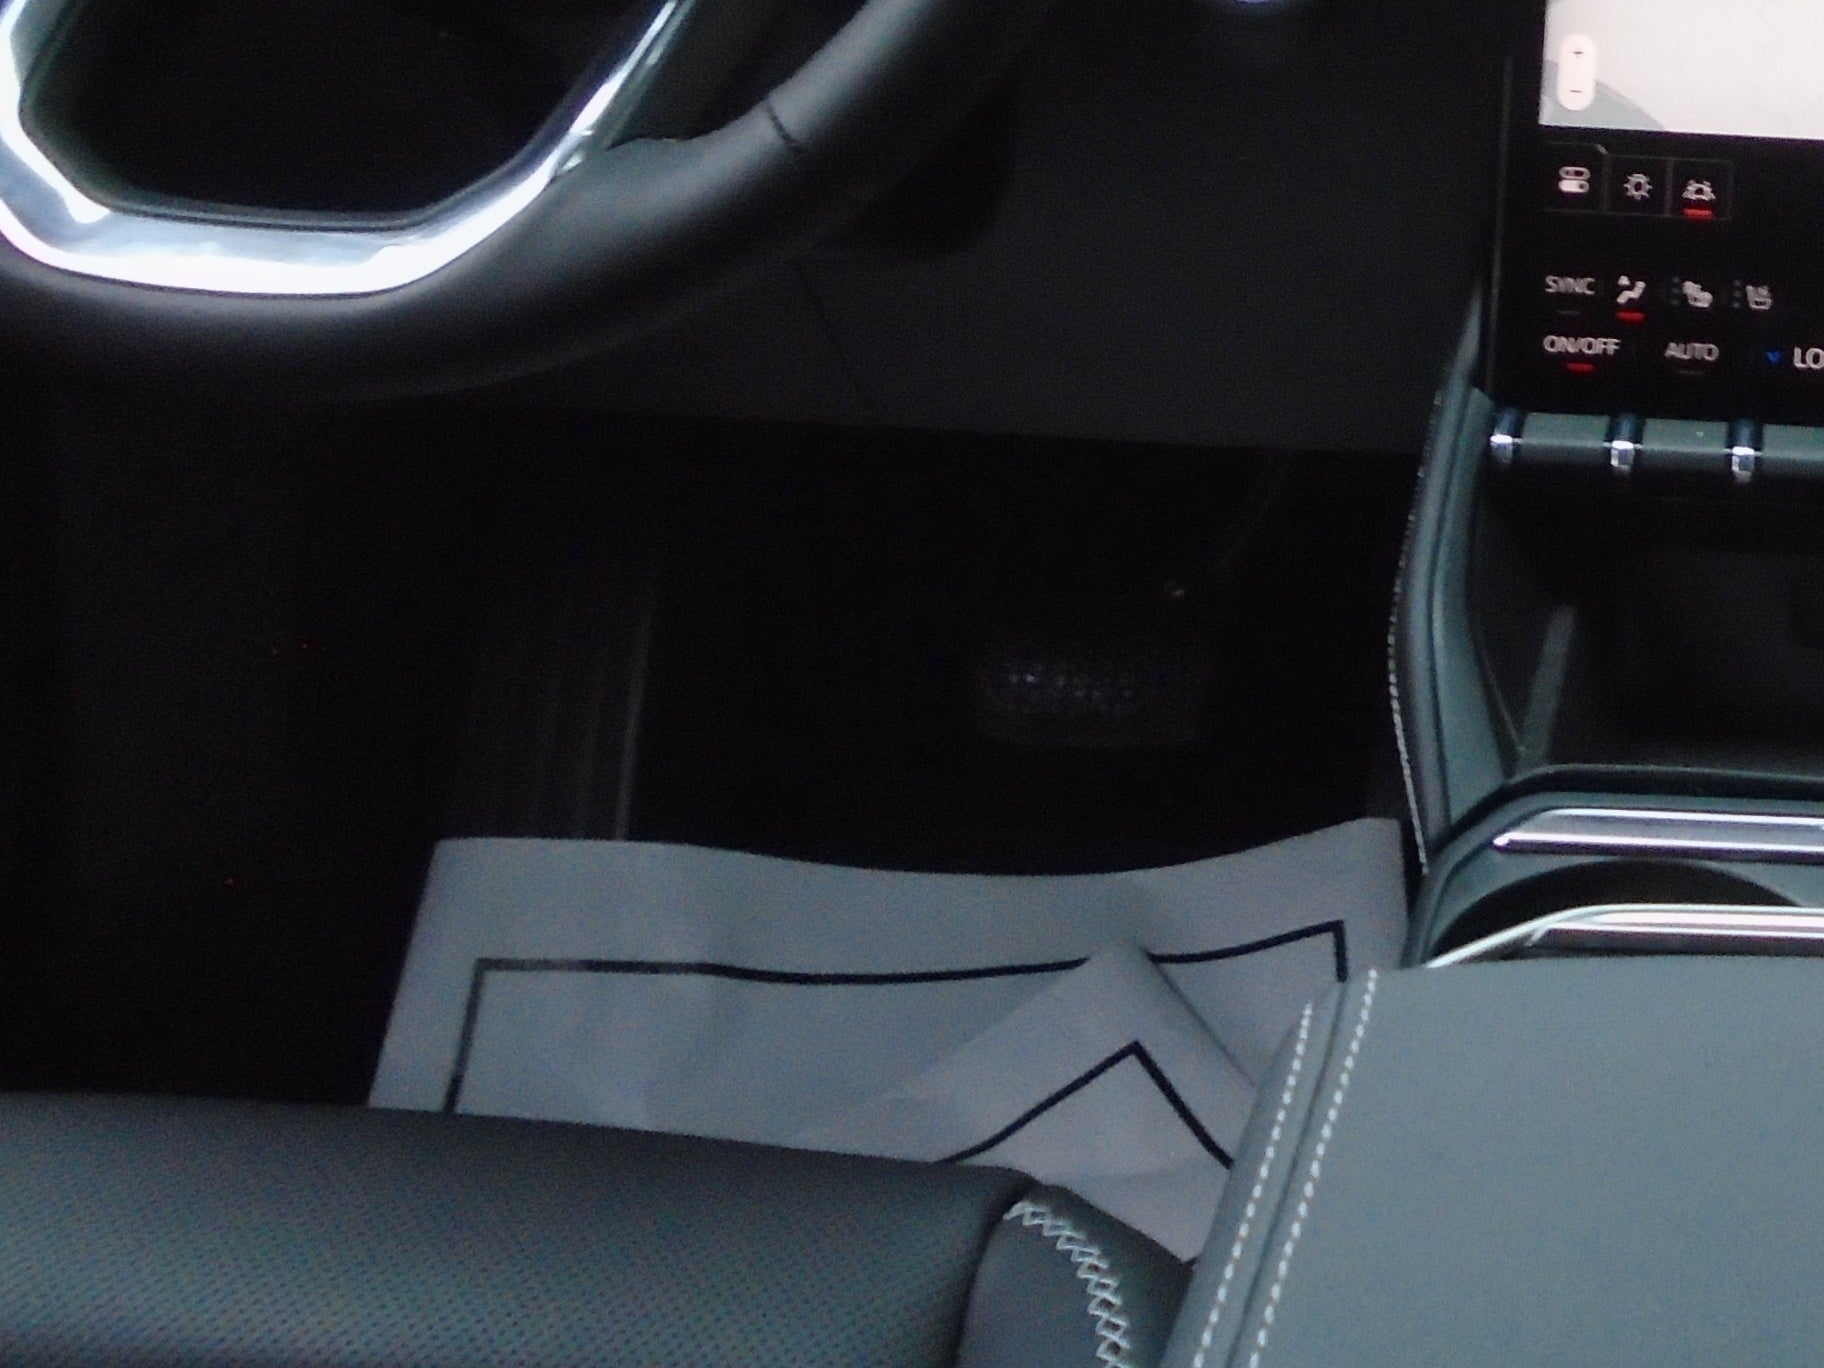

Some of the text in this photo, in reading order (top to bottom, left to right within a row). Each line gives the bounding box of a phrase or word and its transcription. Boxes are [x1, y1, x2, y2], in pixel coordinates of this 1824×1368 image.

[1545, 274, 1596, 296] SYNC
[1542, 334, 1621, 357] ON/OFF
[1665, 340, 1720, 362] AUTO
